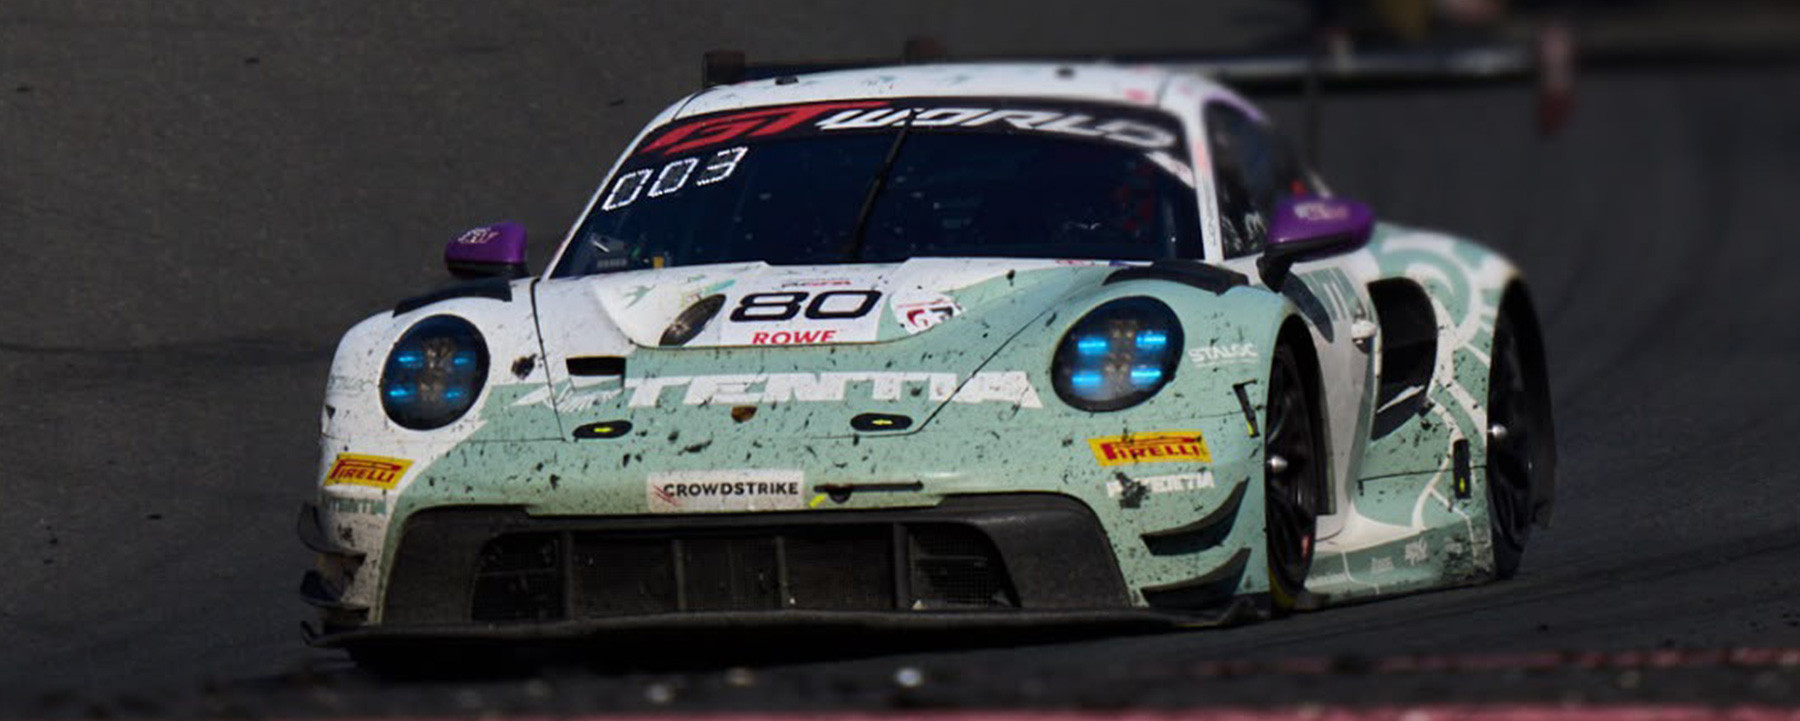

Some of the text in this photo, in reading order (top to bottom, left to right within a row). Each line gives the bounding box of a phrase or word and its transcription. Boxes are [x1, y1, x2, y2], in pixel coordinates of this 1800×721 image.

[639, 101, 1178, 156] GT WORLD
[601, 146, 749, 211] 003
[729, 290, 883, 322] 80
[751, 330, 838, 345] ROWE
[1100, 436, 1202, 460] PIRELLI
[329, 458, 402, 483] PIRELLI
[663, 481, 799, 497] CROWDSTRIKE
